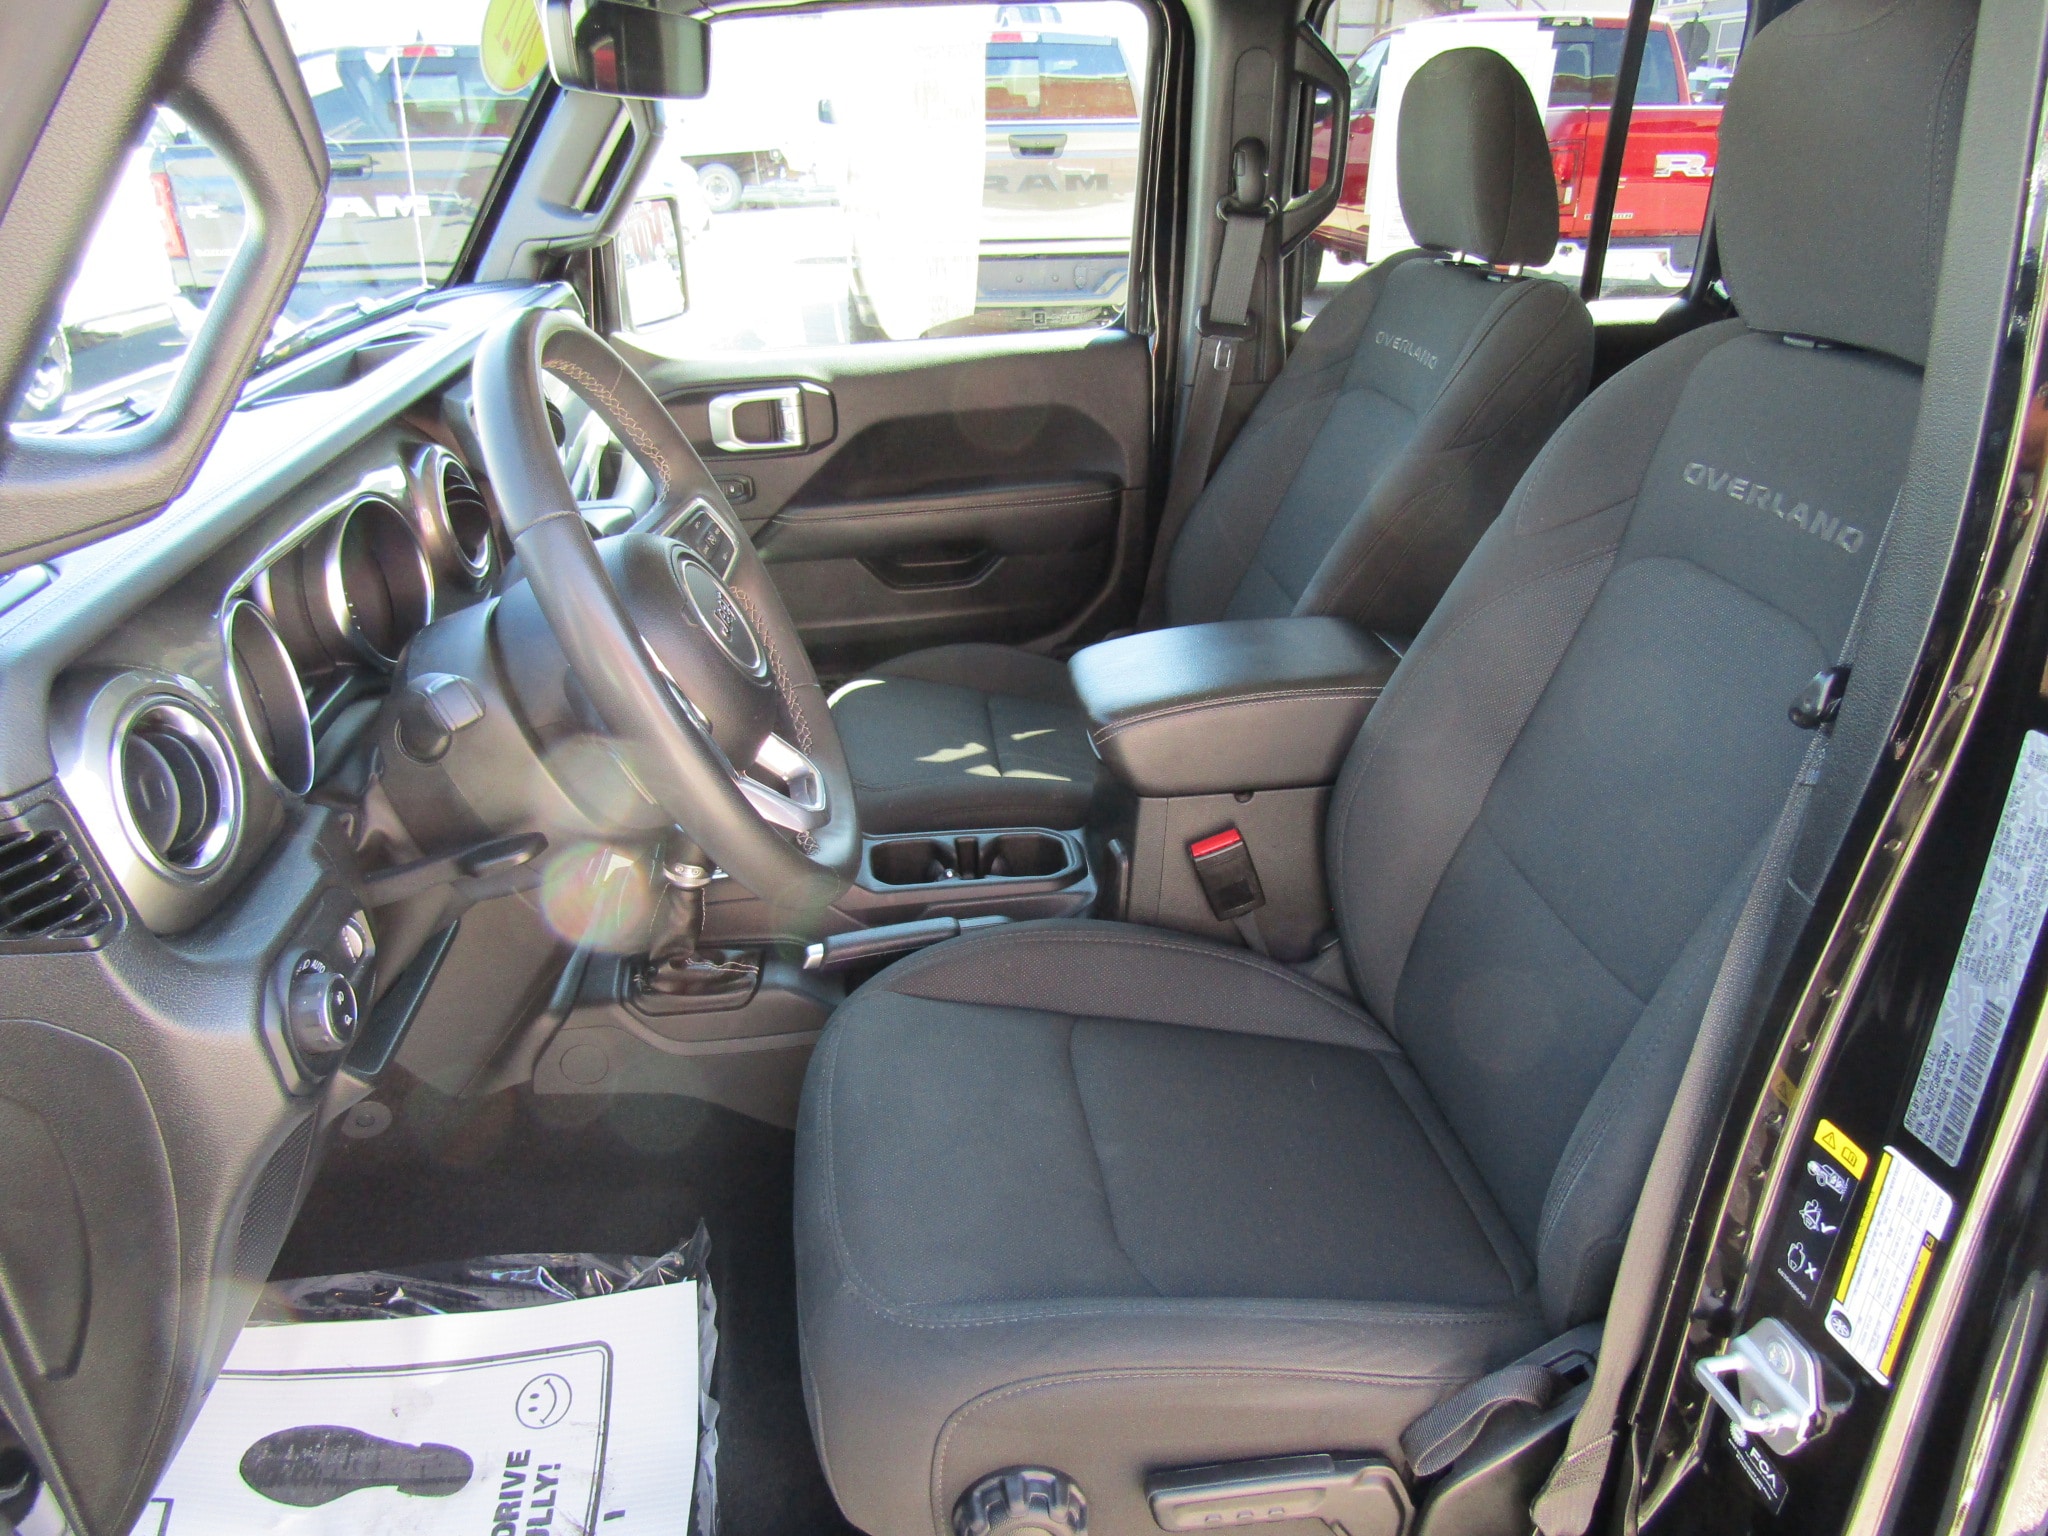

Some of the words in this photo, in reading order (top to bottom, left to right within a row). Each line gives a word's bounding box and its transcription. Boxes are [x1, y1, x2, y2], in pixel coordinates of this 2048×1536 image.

[325, 196, 432, 218] AM
[1375, 331, 1438, 370] OVERLAND
[1683, 462, 1864, 553] OVERLAND
[311, 959, 326, 974] AUTO
[1926, 1049, 1937, 1067] LLC
[1922, 1064, 1932, 1078] US
[1923, 1111, 1941, 1144] VEHICLE
[1934, 1087, 1949, 1112] MADE
